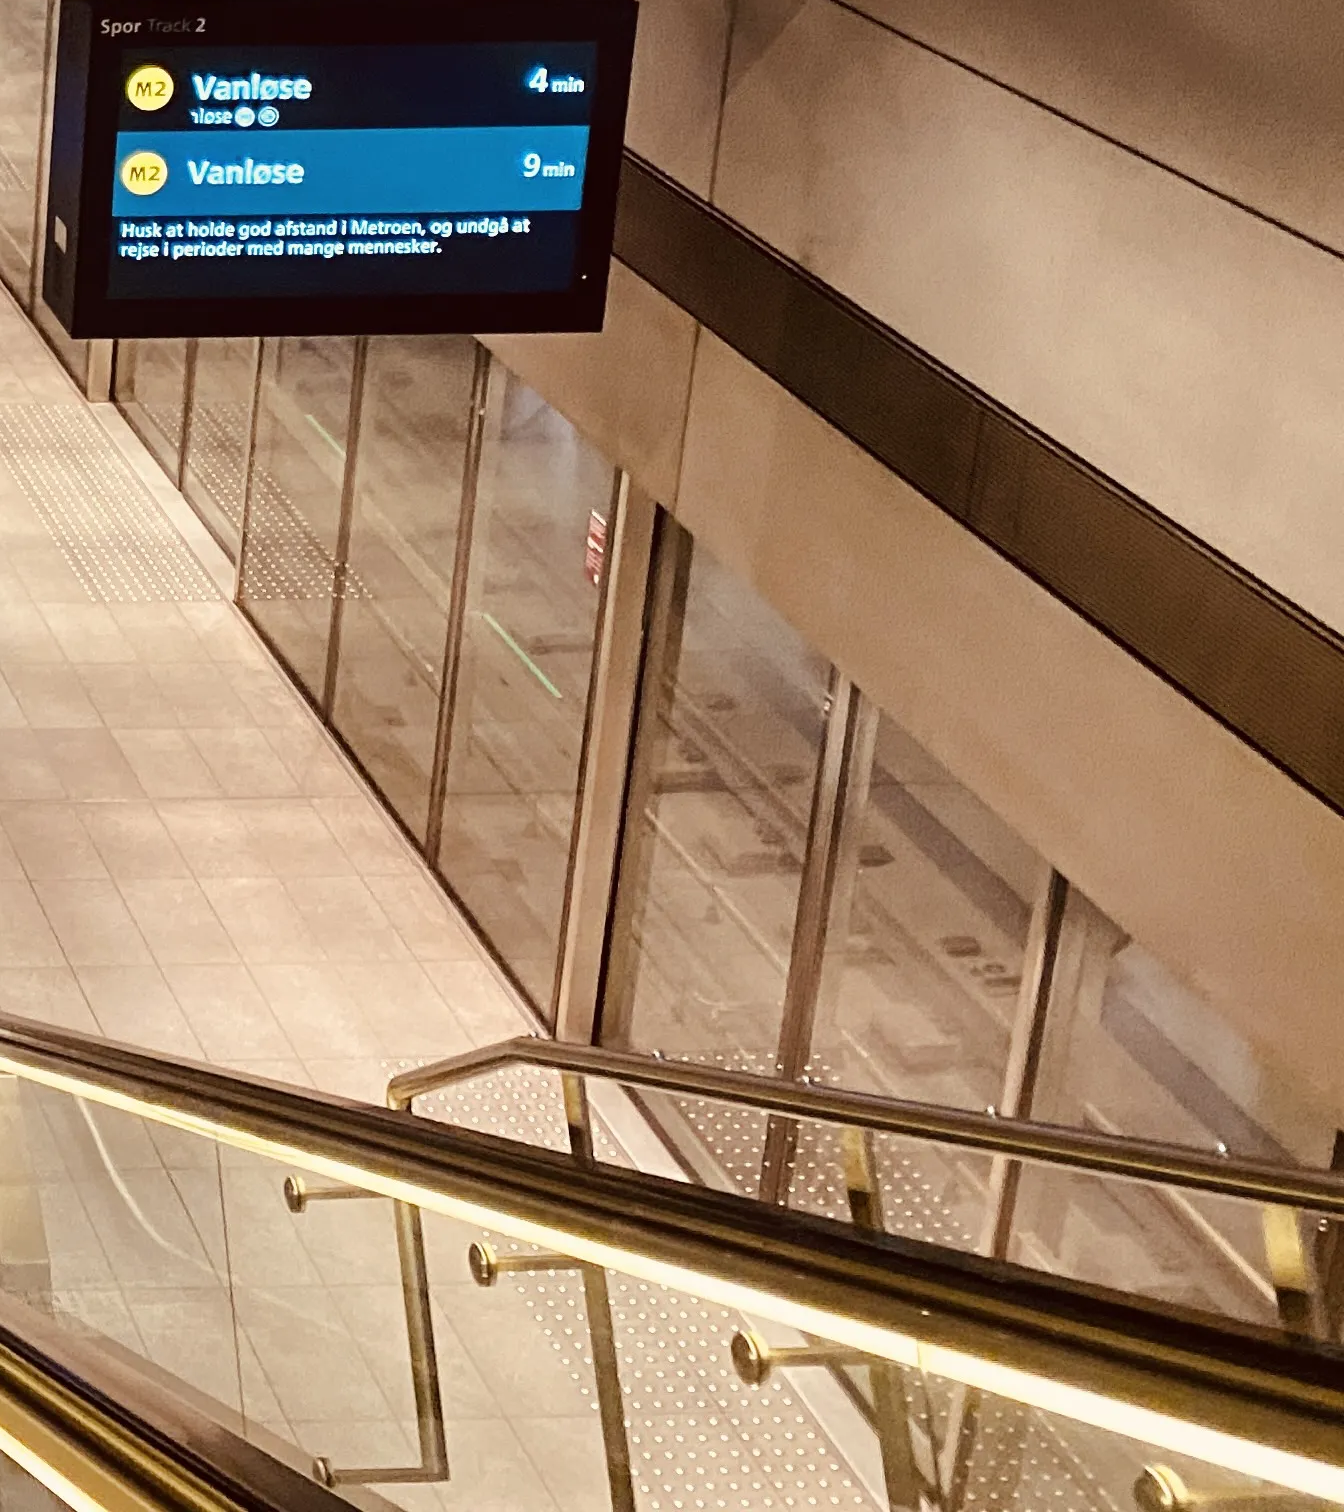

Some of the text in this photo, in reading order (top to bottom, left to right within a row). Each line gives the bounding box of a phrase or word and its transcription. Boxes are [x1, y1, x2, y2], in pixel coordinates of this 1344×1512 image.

[100, 16, 206, 37] Spor Track 2
[135, 67, 585, 101] M2 Vanløse 4 min
[129, 153, 576, 185] M2 Vanløse 9 min
[121, 217, 531, 240] Husk at holde god afstand i Metroen, og undgå at
[120, 238, 443, 261] rejse i perioder med mange mennesker.
